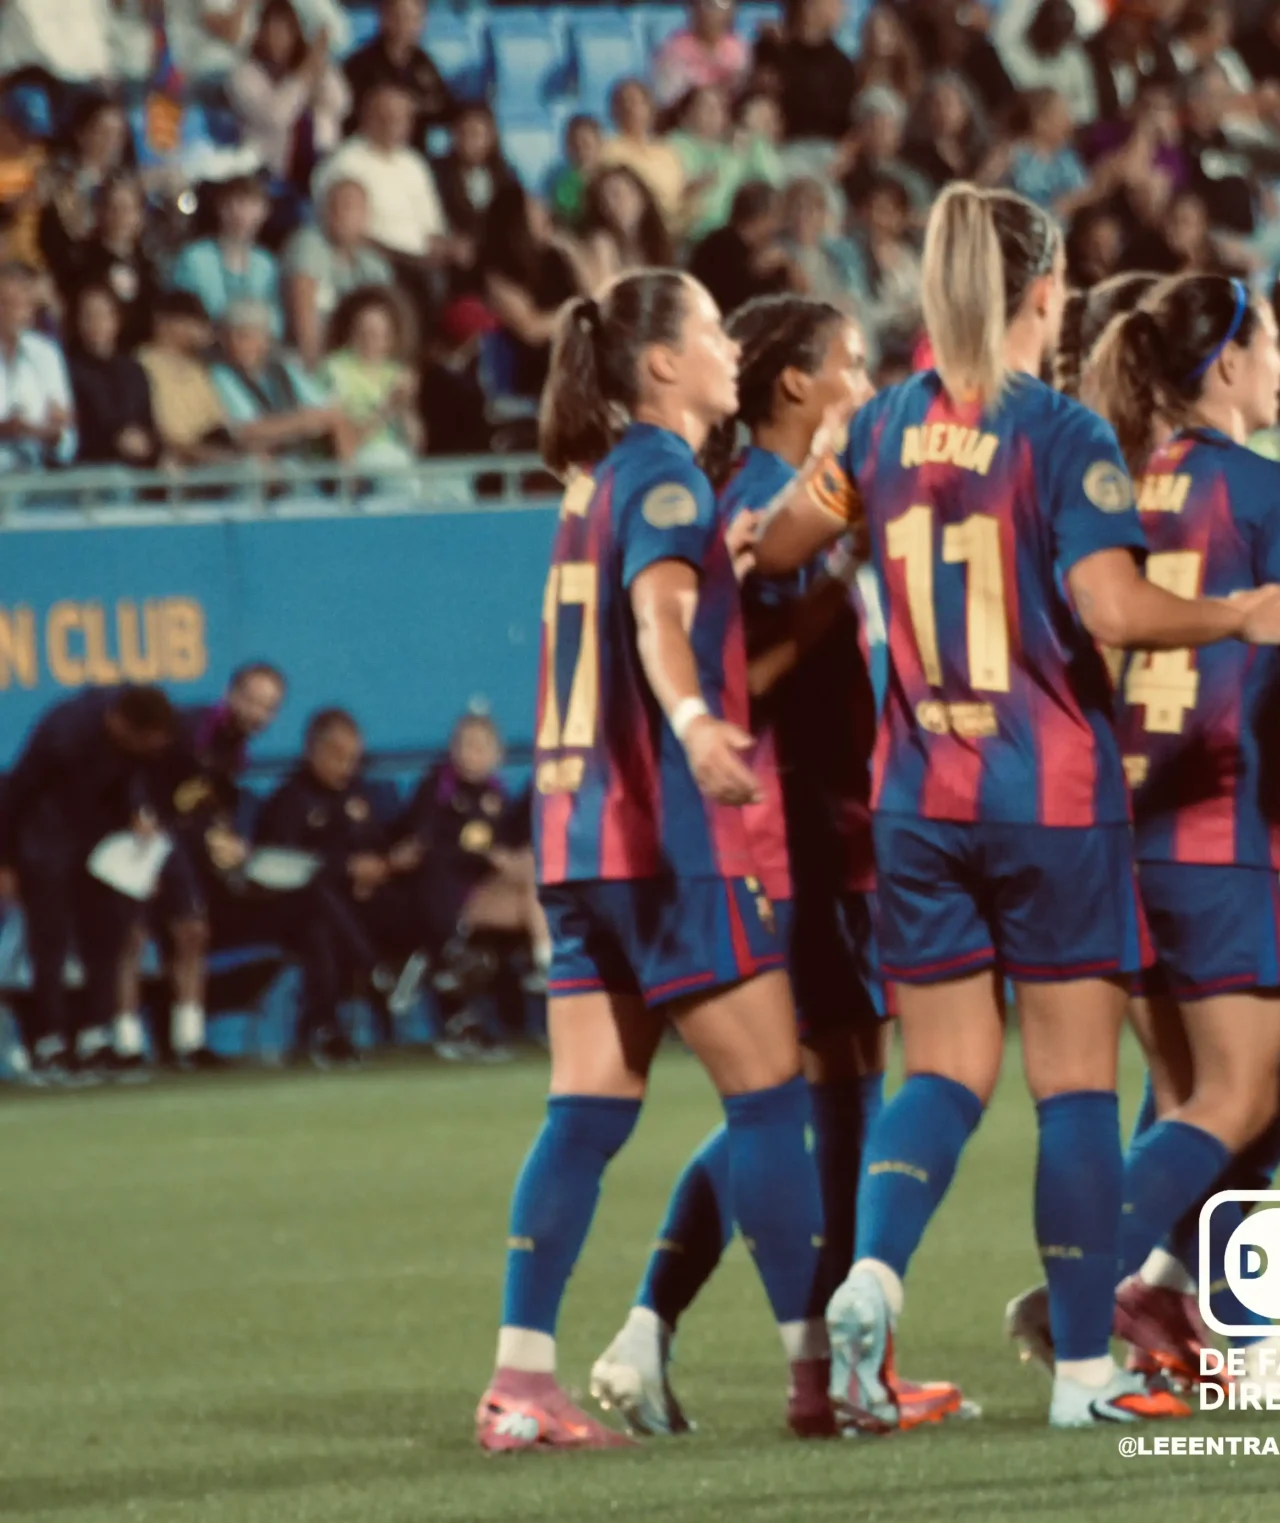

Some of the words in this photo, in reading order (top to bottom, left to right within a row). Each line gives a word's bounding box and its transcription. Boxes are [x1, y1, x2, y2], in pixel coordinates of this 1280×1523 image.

[46, 595, 208, 687] CLUB
[536, 562, 598, 749] 17
[886, 504, 1011, 693] 11
